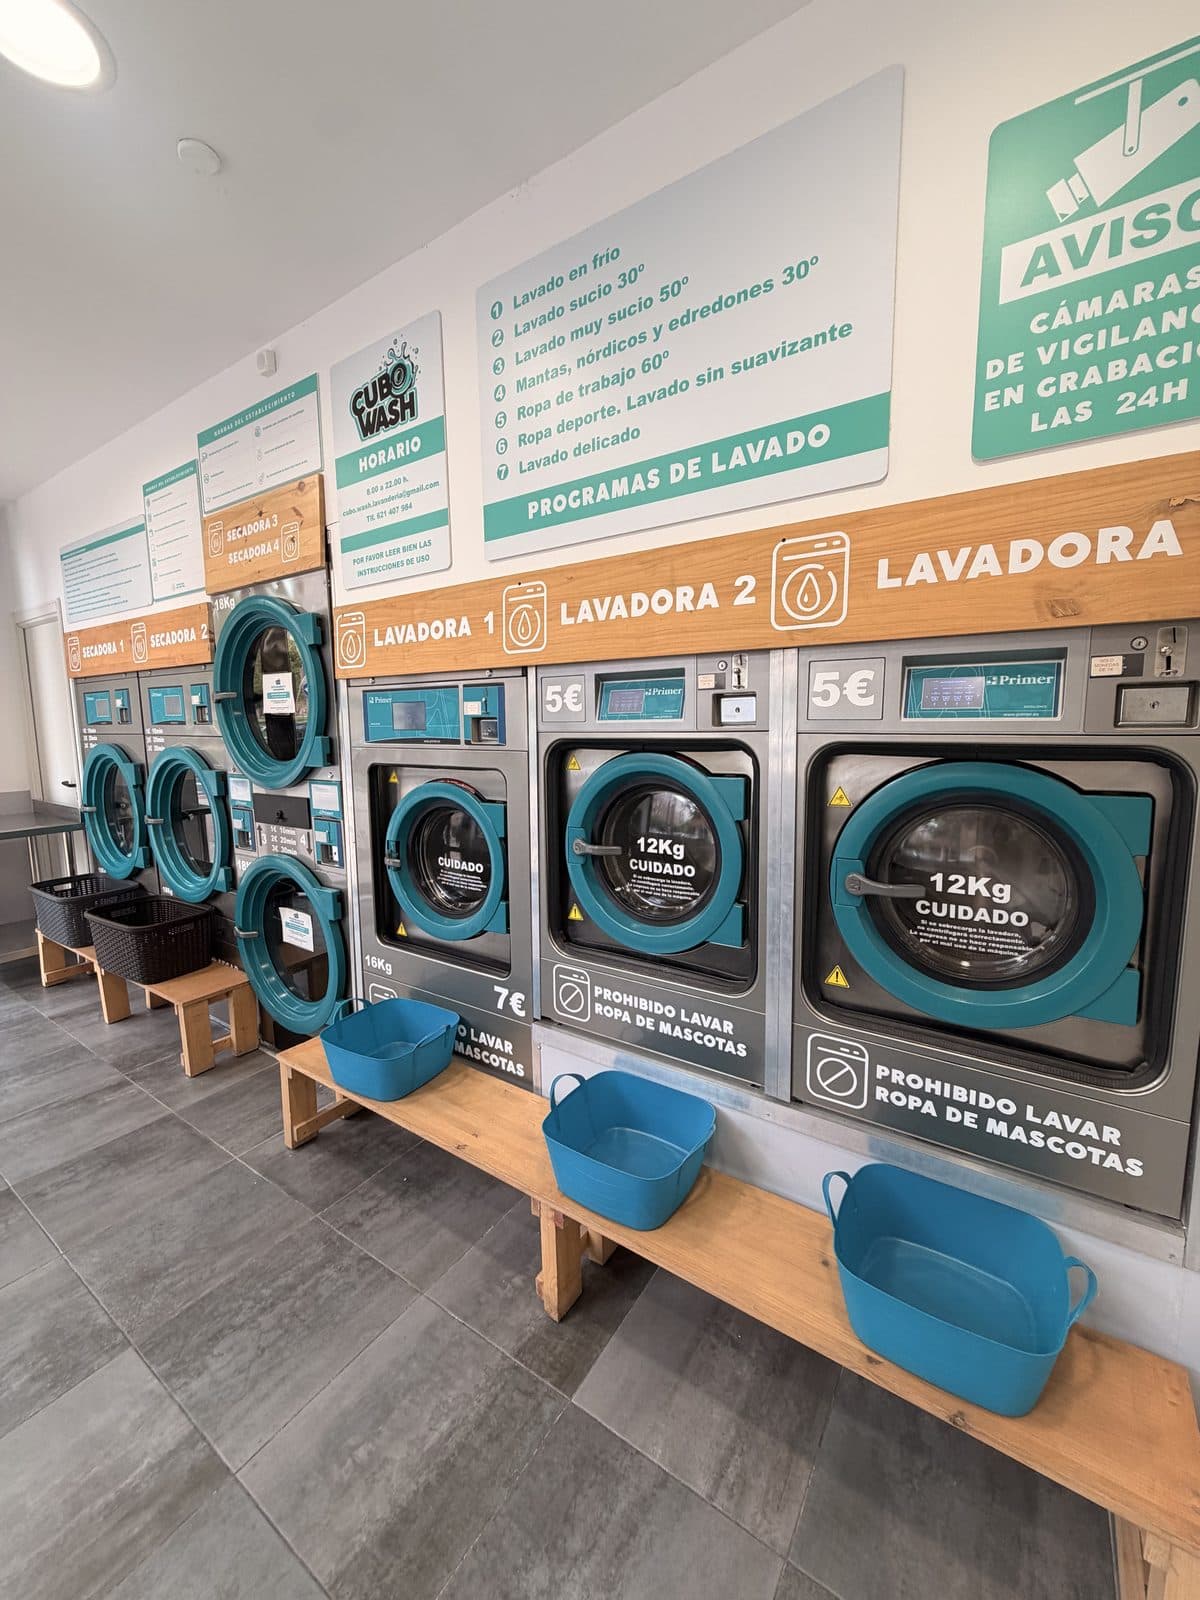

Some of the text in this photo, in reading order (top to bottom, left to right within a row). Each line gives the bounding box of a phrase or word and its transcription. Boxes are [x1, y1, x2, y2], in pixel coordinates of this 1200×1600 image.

[513, 275, 564, 309] Lavado
[569, 262, 588, 282] en
[592, 246, 621, 271] frío
[514, 304, 565, 338] Lavado
[569, 284, 612, 311] sucio
[1030, 265, 1200, 334] CÁMARAS
[515, 334, 566, 366] Lavado
[570, 318, 603, 343] muy
[607, 297, 654, 326] sucio
[516, 363, 572, 393] Mantas,
[576, 329, 648, 368] nórdicos
[652, 323, 663, 343] y
[668, 278, 775, 332] edredones
[984, 341, 1200, 412] EN GRABACI
[985, 351, 1025, 380] DE
[352, 361, 410, 416] CUBO
[517, 426, 553, 449] Ropa
[556, 406, 622, 441] deporte.
[626, 378, 690, 411] Lavado
[695, 366, 725, 388] sin
[730, 320, 853, 375] suavizante
[517, 397, 553, 421] Ropa
[555, 387, 574, 407] de
[578, 366, 636, 400] trabajo
[357, 392, 416, 438] WASH
[1030, 378, 1188, 433] LAS 24H
[359, 436, 421, 473] HORARIO
[518, 449, 569, 475] Lavado
[572, 425, 641, 458] delicado
[385, 477, 402, 490] 22.00
[527, 423, 832, 519] PROGRAMAS DE LAVADO
[226, 514, 279, 542] SECADORA 3
[228, 538, 280, 564] SECADORA 4
[353, 539, 432, 566] POR FAVOR LEER BIEN LAS
[357, 554, 430, 577] INSTRUCCIONES DE USO
[877, 519, 1183, 590] LAVADORA
[214, 597, 235, 611] 18Kg
[560, 574, 757, 626] LAVADORA 2
[150, 623, 208, 649] SECADORA 2
[373, 611, 495, 647] LAVADORA 1
[82, 639, 125, 659] SECADORA 1
[652, 687, 683, 696] Primer
[811, 670, 875, 708] 5€
[999, 675, 1055, 686] Primer
[545, 684, 583, 713] 5€
[262, 833, 267, 845] 3
[300, 834, 306, 845] 4
[637, 837, 684, 860] 12Kg
[438, 856, 484, 873] CUIDADO
[629, 859, 696, 877] CUIDADO
[930, 873, 1011, 904] 12Kg
[915, 900, 1029, 927] CUIDADO
[938, 922, 977, 933] sobrecarga
[919, 931, 948, 940] empresa
[969, 938, 987, 947] hace
[365, 955, 393, 975] 16Kg
[493, 985, 526, 1017] 7€
[594, 985, 734, 1035] PROHIBIDO LAVAR
[470, 1028, 513, 1055] LAVAR
[594, 1002, 748, 1058] ROPA DE MASCOTAS
[455, 1040, 525, 1077] MASCOTAS
[876, 1064, 1121, 1146] PROHIBIDO LAVAR
[875, 1086, 1144, 1178] ROPA DE MASCOTAS
